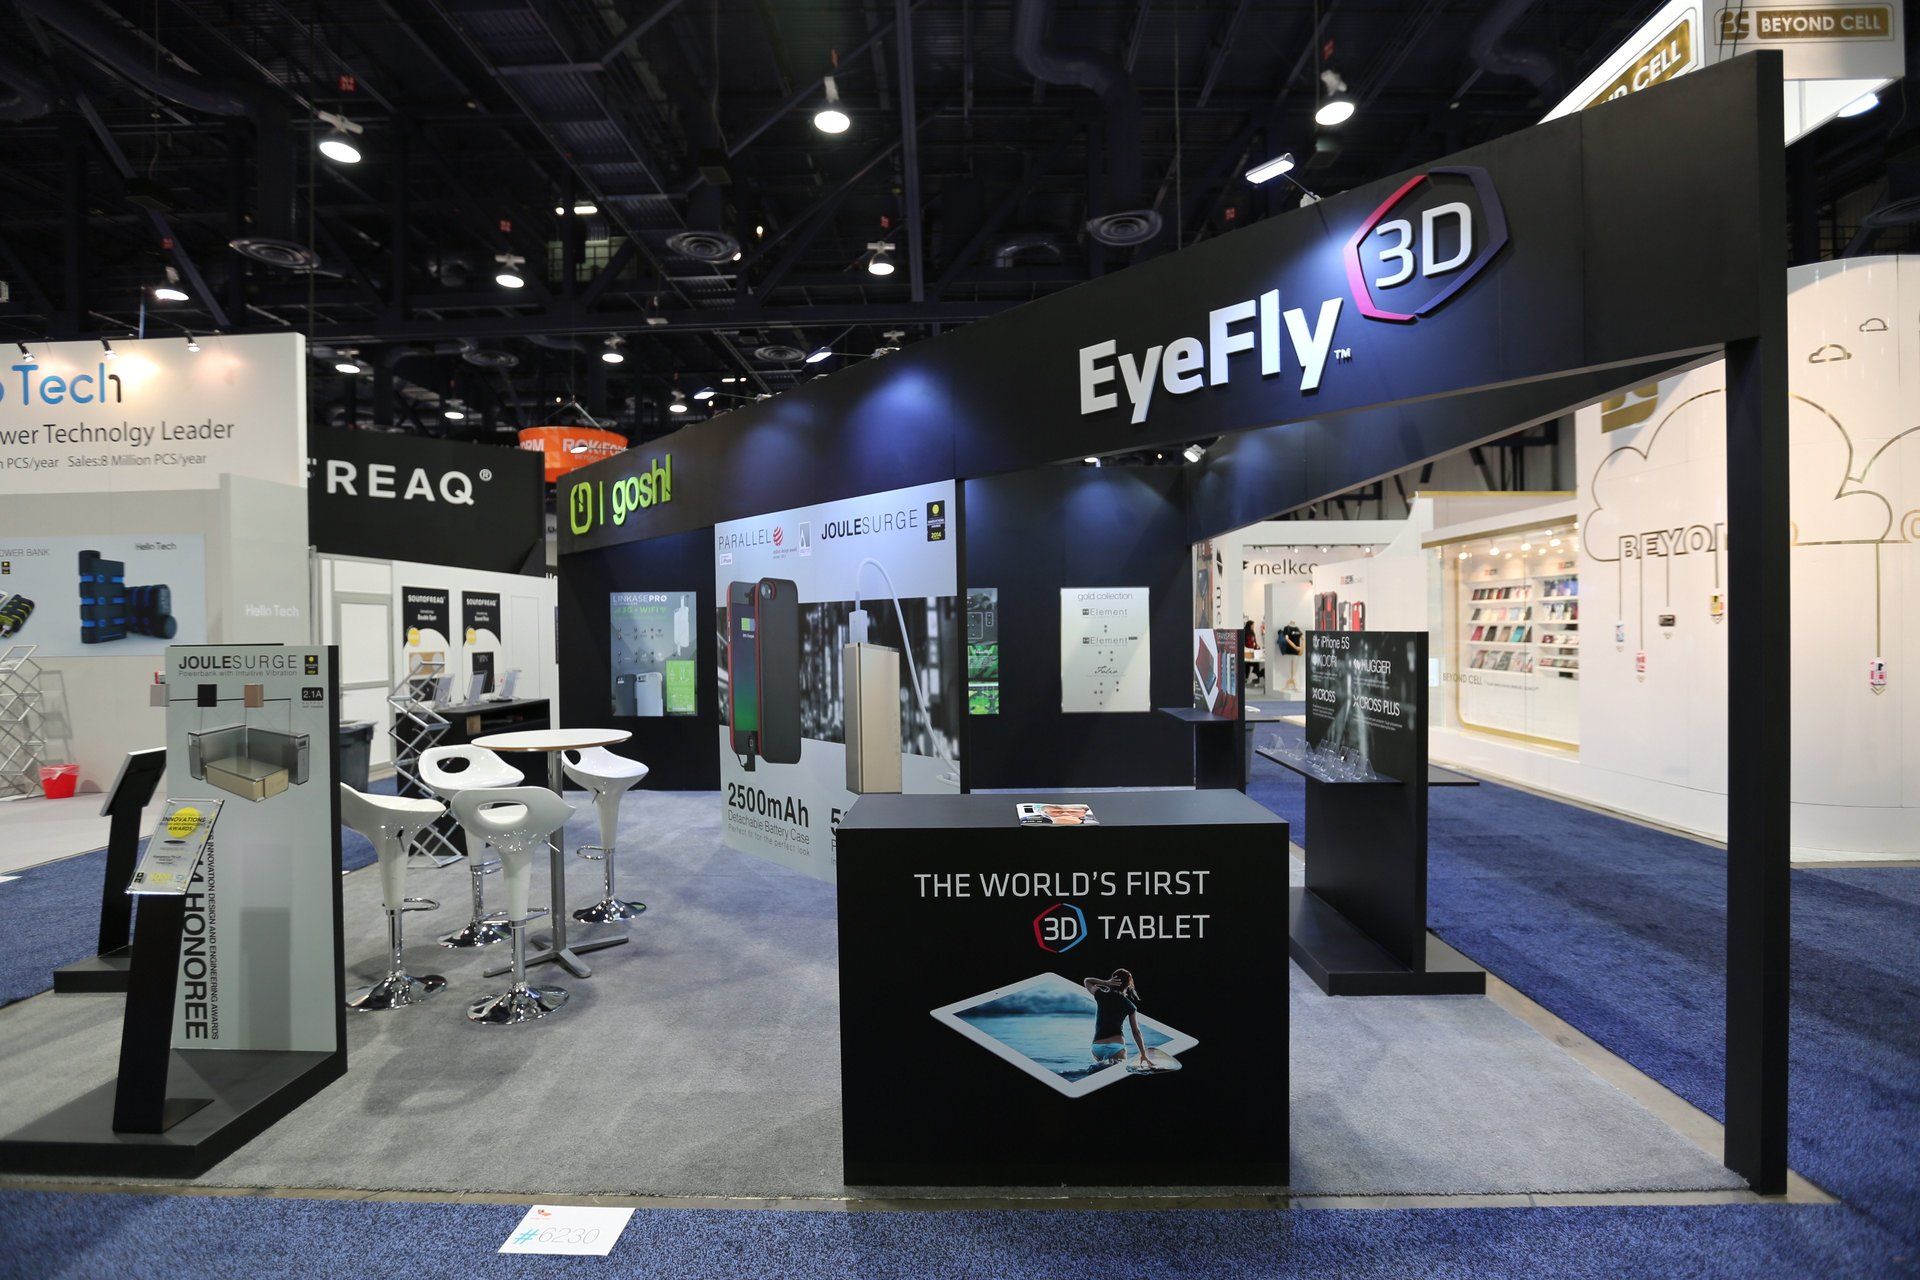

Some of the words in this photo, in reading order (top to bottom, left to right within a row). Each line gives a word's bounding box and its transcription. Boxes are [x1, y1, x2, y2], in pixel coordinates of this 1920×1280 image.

[1761, 16, 1834, 33] BEYOND
[1840, 15, 1881, 31] CELL
[1633, 40, 1681, 92] CELL
[1375, 201, 1473, 289] 3D
[1079, 289, 1343, 424] EyeFly
[11, 362, 122, 405] Tech
[43, 421, 155, 447] Technolgy
[162, 418, 235, 440] Leader
[7, 457, 58, 471] PCS/year
[154, 453, 206, 467] PCS/year
[822, 509, 918, 540] JOULESURGE
[26, 548, 50, 557] BANK
[719, 529, 771, 550] PARALLEL
[1619, 522, 1728, 558] BEYO
[245, 604, 272, 617] Hello
[273, 604, 300, 617] Tech
[1078, 592, 1095, 602] gold
[1097, 591, 1133, 600] collection
[1089, 608, 1128, 616] Element
[1321, 636, 1341, 649] iPhone
[1341, 636, 1350, 650] 5S
[179, 654, 297, 669] JOULESURGE
[1443, 672, 1467, 684] BEYOND
[1468, 674, 1483, 686] CELL
[303, 690, 322, 699] 2.1A
[1383, 700, 1401, 717] PLUS
[728, 782, 809, 828] 2500mAh
[728, 810, 764, 831] Detachable
[765, 820, 789, 841] Battery
[790, 828, 810, 845] Case
[207, 841, 216, 891] INNOVATION
[914, 873, 971, 898] THE
[979, 871, 1116, 898] WORLD'S
[1126, 870, 1210, 896] FIRST
[208, 893, 216, 924] DESIGN
[1044, 917, 1078, 941] 3D
[1098, 915, 1210, 940] TABLET
[183, 893, 208, 1039] HONOREE
[209, 945, 218, 1002] ENGINEERING
[211, 1003, 219, 1040] AWARDS
[513, 1227, 600, 1245] #6230
